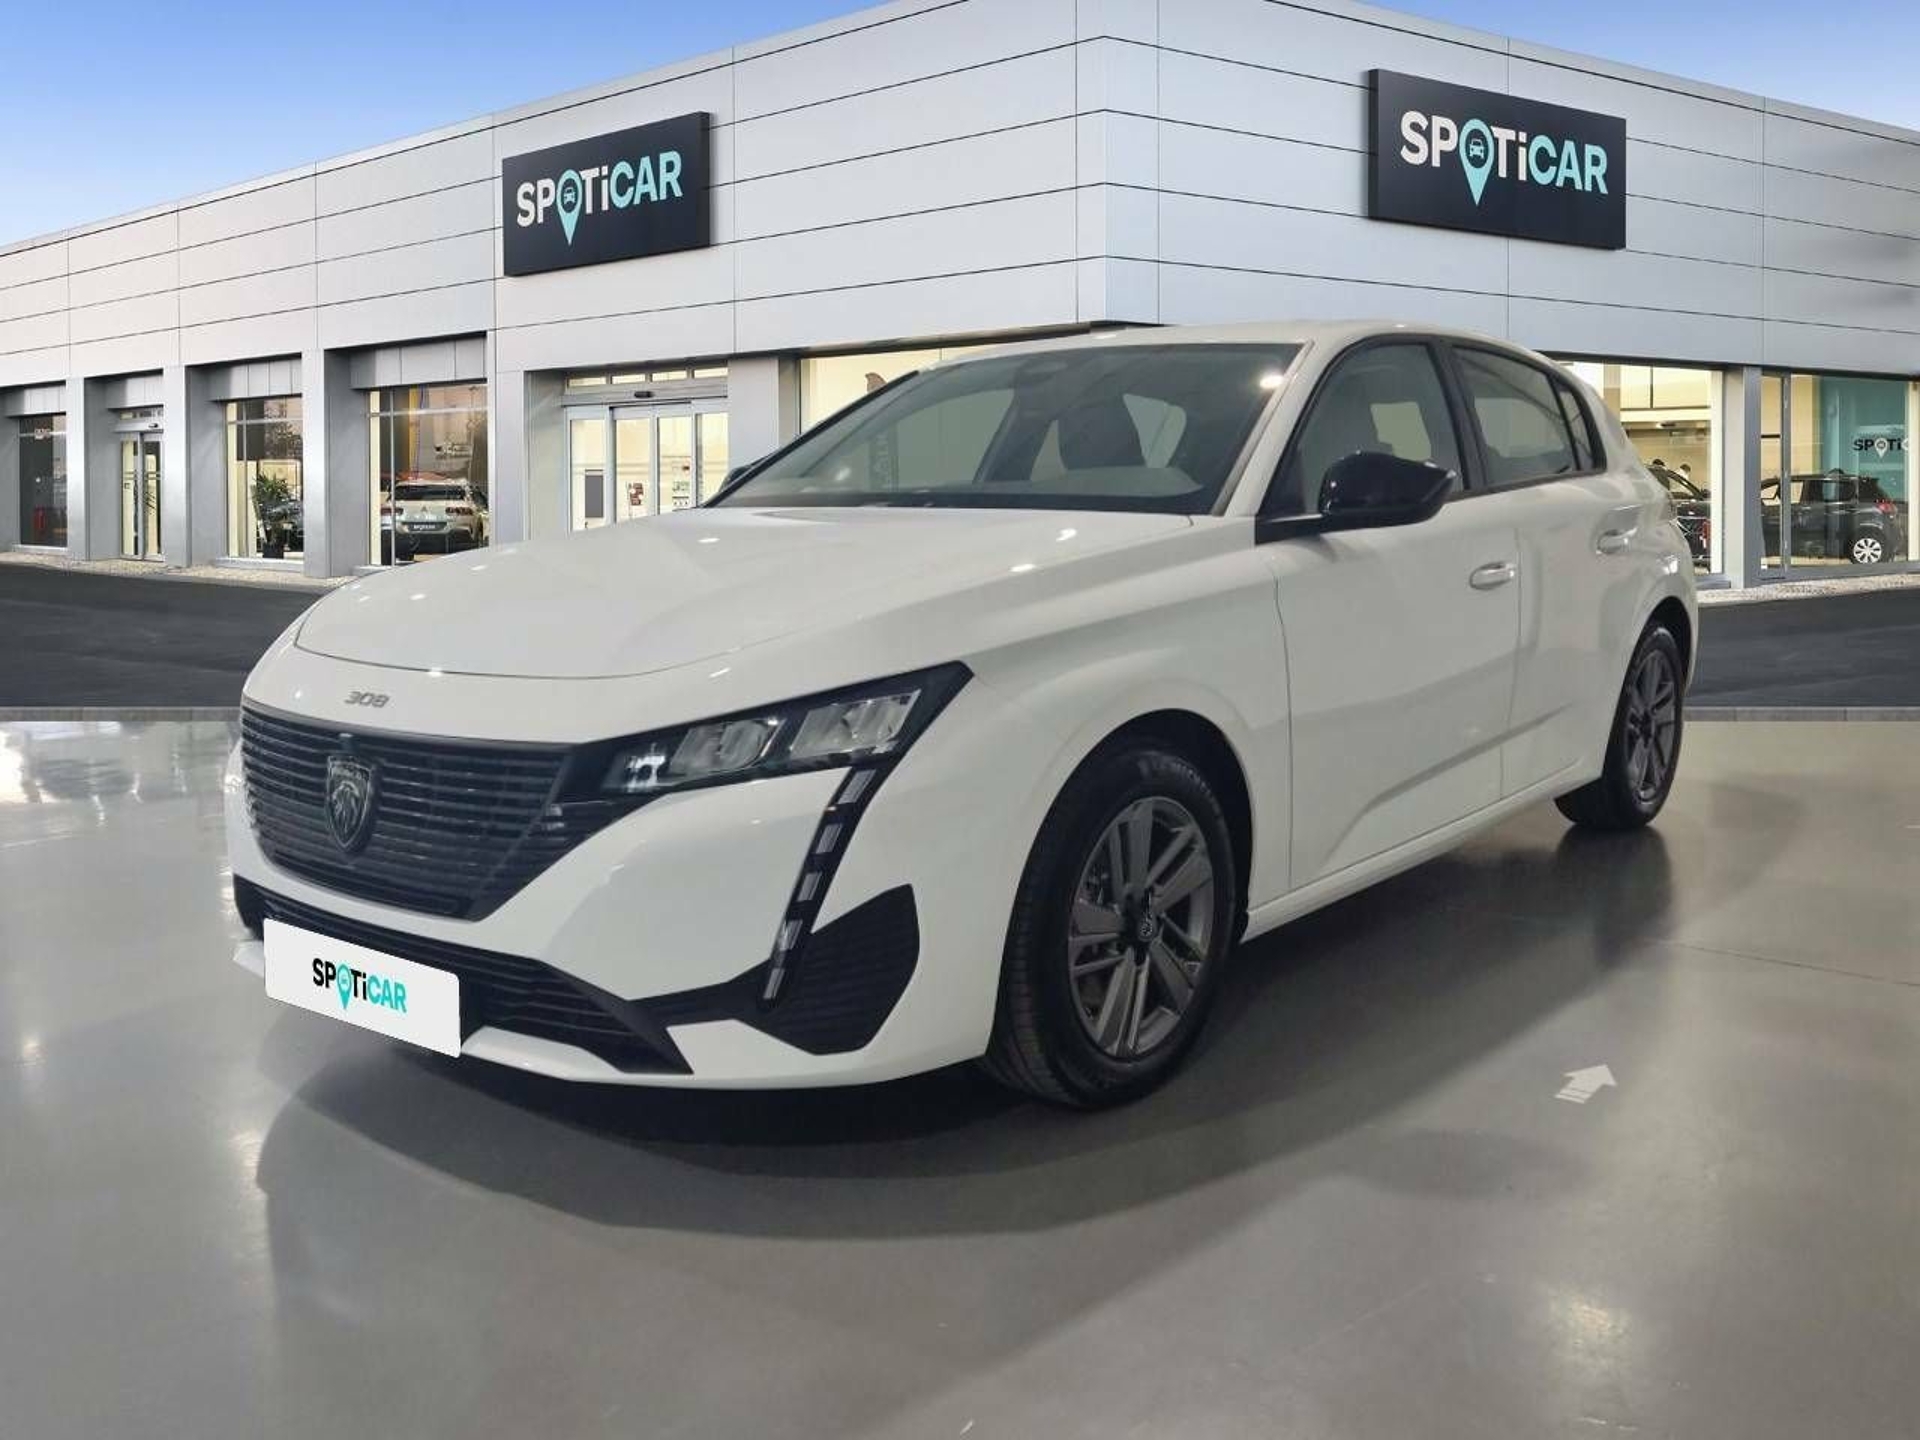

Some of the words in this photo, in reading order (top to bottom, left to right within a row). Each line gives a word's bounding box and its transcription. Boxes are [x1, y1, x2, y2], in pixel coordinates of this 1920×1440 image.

[1400, 110, 1608, 206] SPOTiCAR
[516, 150, 683, 246] SPOTiCAR
[344, 691, 389, 708] 308
[312, 957, 407, 1013] SPOTiCAR
